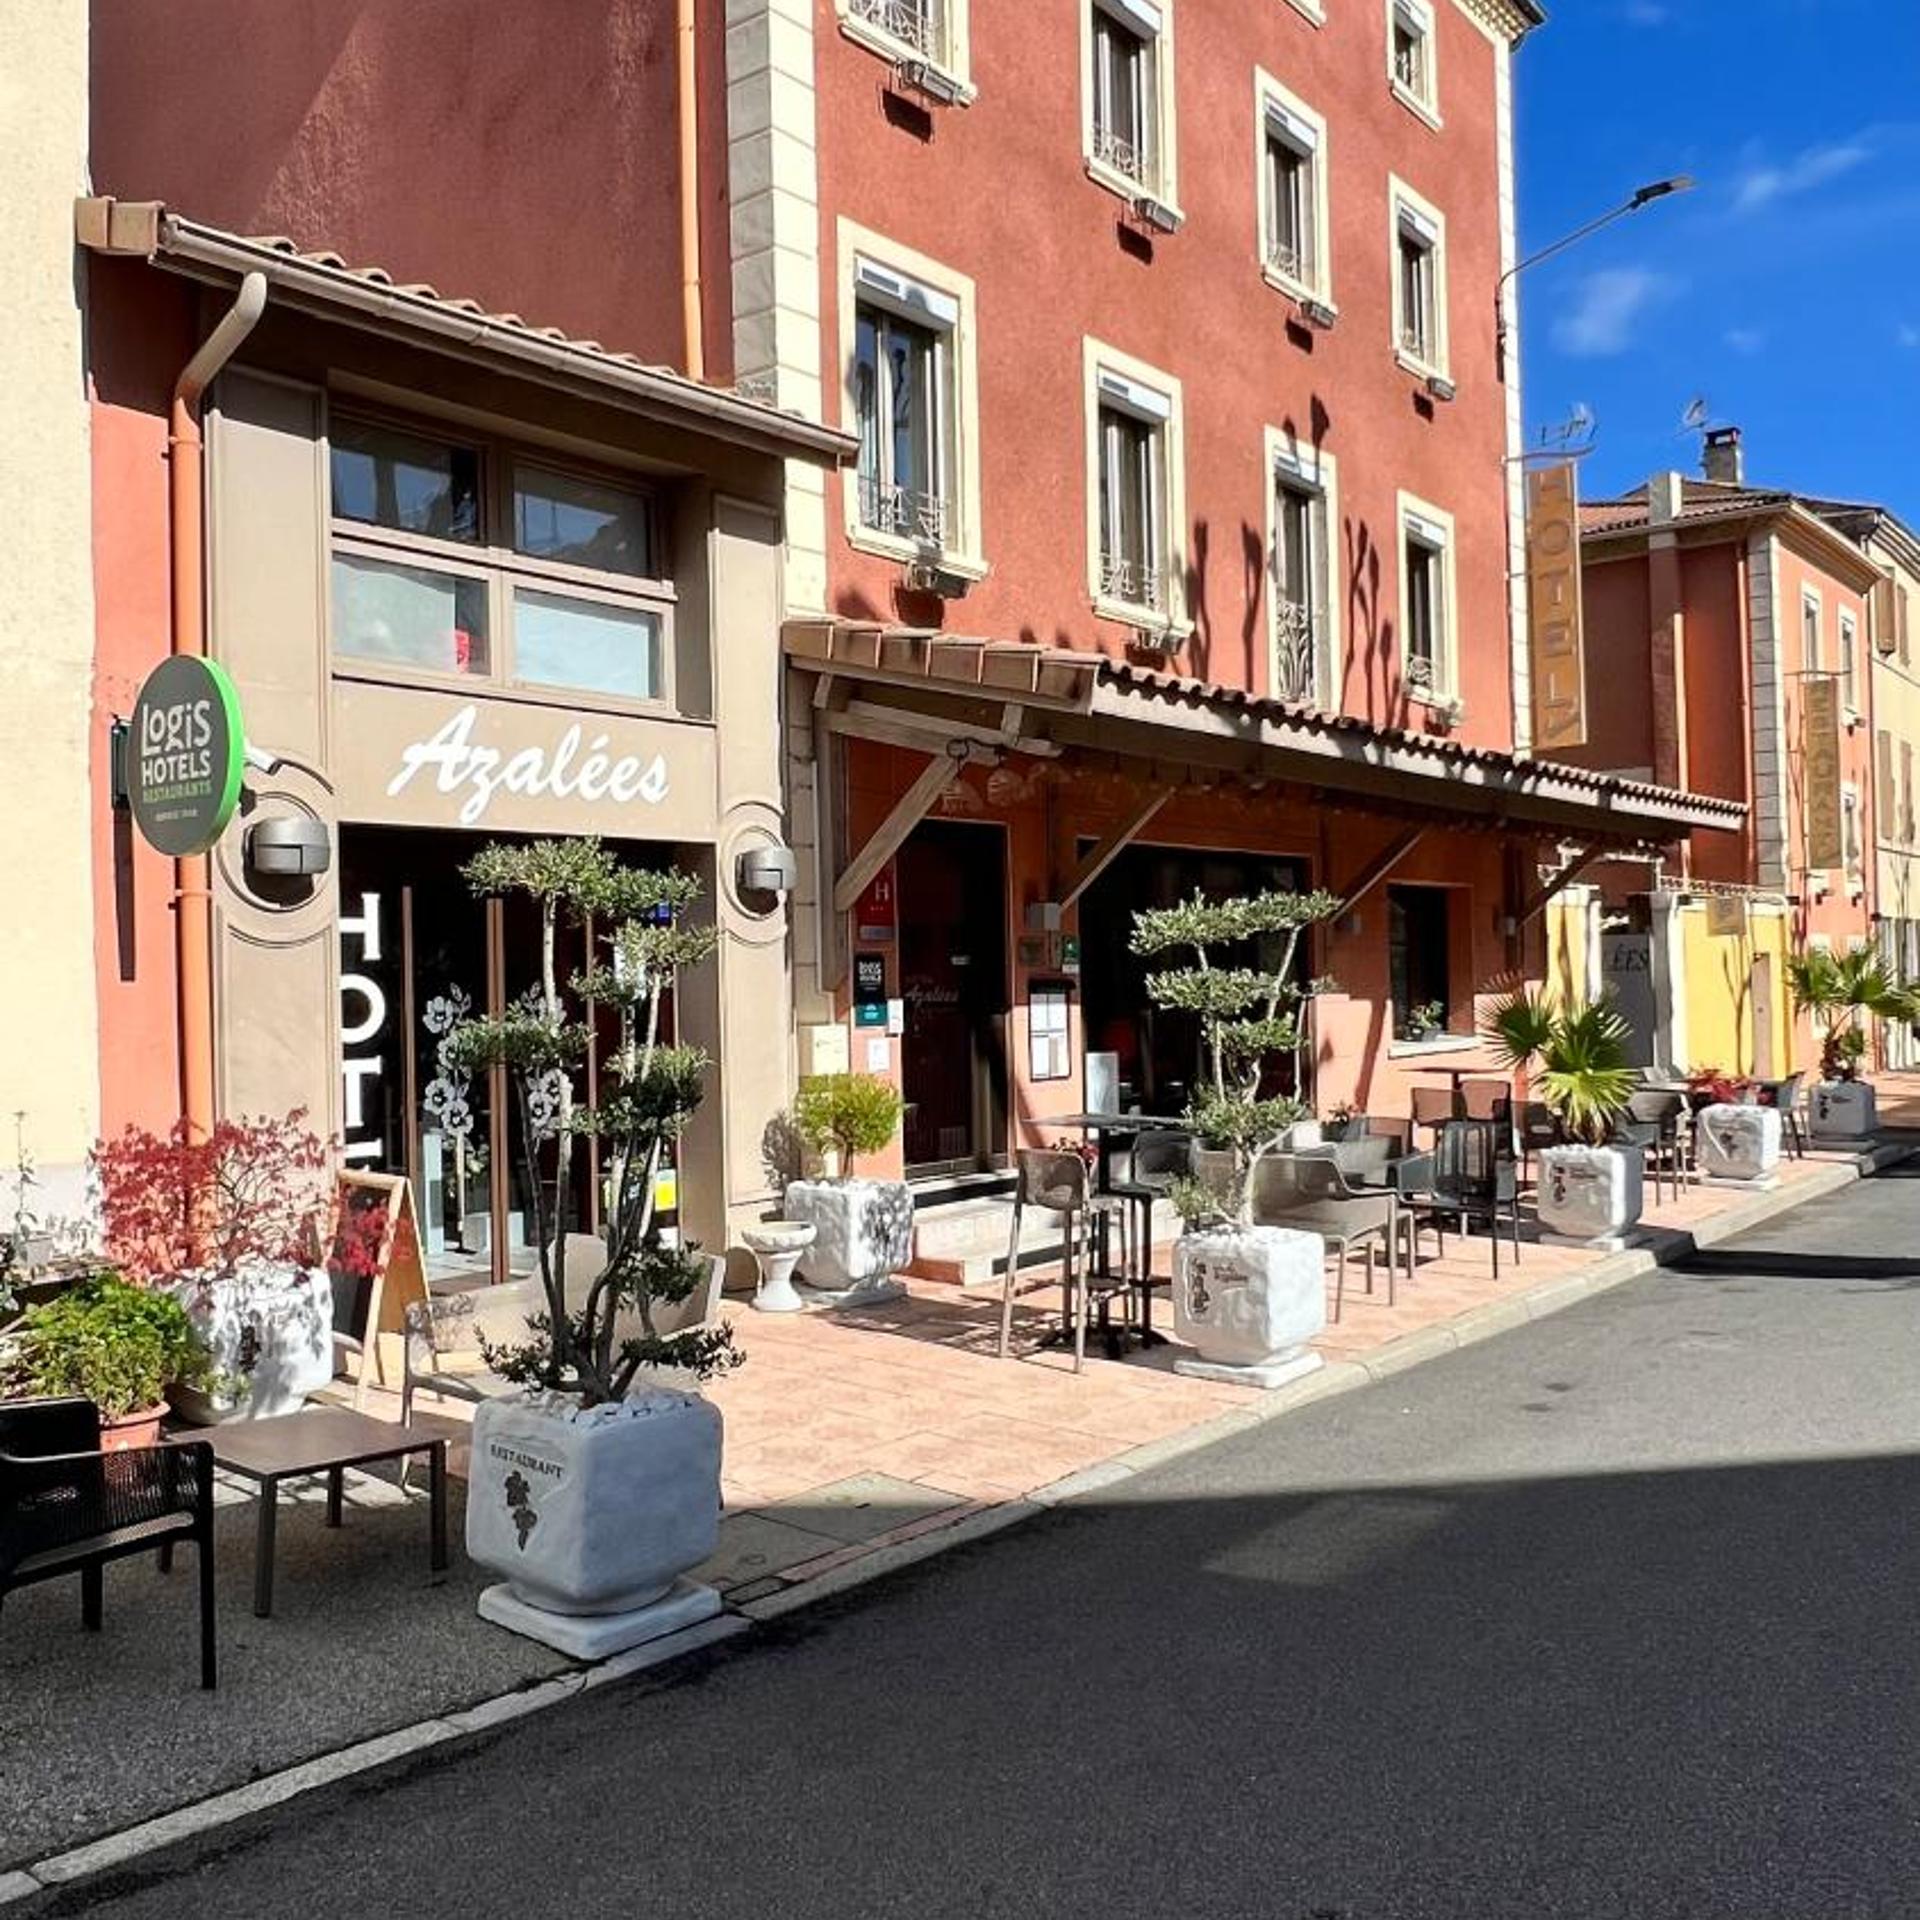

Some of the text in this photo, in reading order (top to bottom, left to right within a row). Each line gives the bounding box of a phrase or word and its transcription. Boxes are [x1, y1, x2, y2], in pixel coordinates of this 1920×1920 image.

[142, 750, 212, 786] HOTELS
[386, 705, 670, 822] Azalées
[875, 881, 889, 901] H
